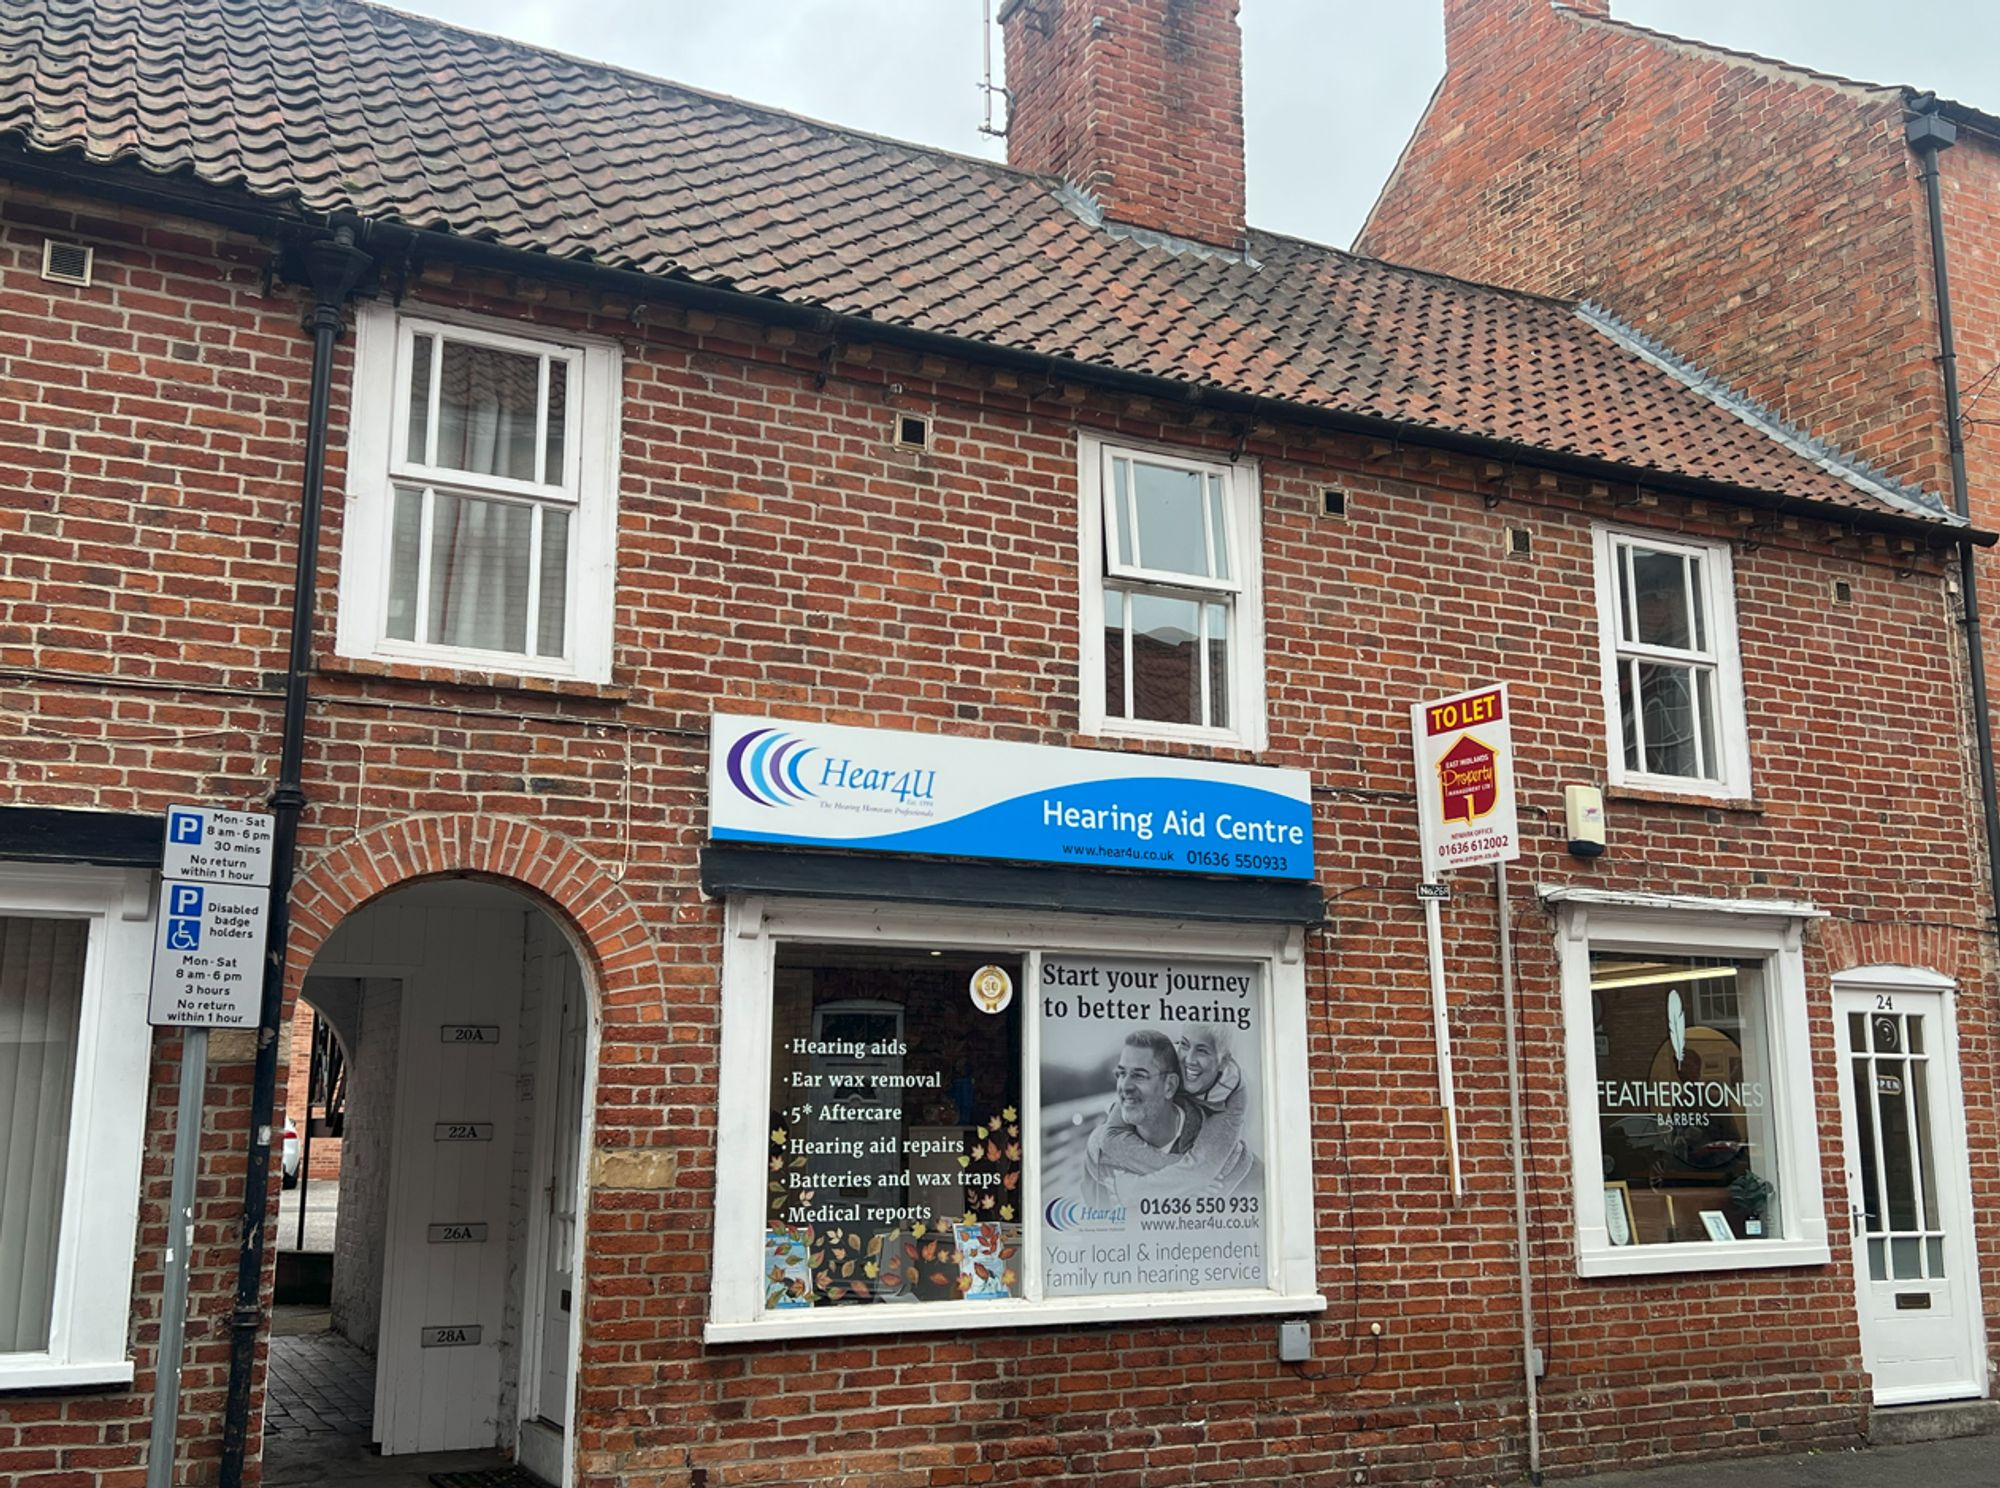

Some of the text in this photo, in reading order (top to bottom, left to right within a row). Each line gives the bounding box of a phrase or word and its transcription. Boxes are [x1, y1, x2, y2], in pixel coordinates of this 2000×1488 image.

[1431, 695, 1496, 730] TO LET
[819, 757, 936, 803] Hear4U
[1439, 765, 1493, 792] Property
[834, 802, 861, 813] Hearing
[178, 816, 199, 841] P
[1043, 799, 1304, 845] Hearing Aid Centre
[214, 840, 262, 855] 30 mins
[1439, 835, 1509, 857] 01636 612002
[190, 854, 247, 868] No return
[1062, 842, 1288, 871] www.hear4u.co.uk 01636 550933
[180, 866, 255, 880] within 1 hour
[178, 889, 199, 914] P
[208, 902, 259, 915] Disabled
[215, 915, 251, 928] badge
[209, 926, 254, 939] holders
[1043, 963, 1251, 998] Start your journey
[185, 984, 231, 996] 3 hours
[177, 999, 236, 1011] No return
[1876, 994, 1893, 1010] 24
[167, 1011, 244, 1023] within 1 hour
[1043, 995, 1251, 1030] to better hearing
[455, 1029, 484, 1041] 20A
[792, 1038, 907, 1059] Hearing aids
[791, 1071, 942, 1088] Ear wax removal
[1879, 1080, 1900, 1090] PEN
[819, 1104, 902, 1121] Aftercare
[1657, 1112, 1710, 1127] BARBERS
[448, 1127, 478, 1139] 22A
[790, 1136, 965, 1158] Hearing aid repairs
[789, 1170, 1001, 1189] Batteries and wax traps
[788, 1204, 932, 1224] Medical reports
[1141, 1197, 1259, 1215] 01636 550 933
[1080, 1207, 1127, 1224] Hear4U
[1140, 1216, 1259, 1231] www.hear4u.co.uk
[442, 1228, 472, 1240] 26A
[1046, 1241, 1260, 1264] Your local & independent
[1046, 1262, 1261, 1289] family run hearing service
[436, 1330, 466, 1343] 28A
